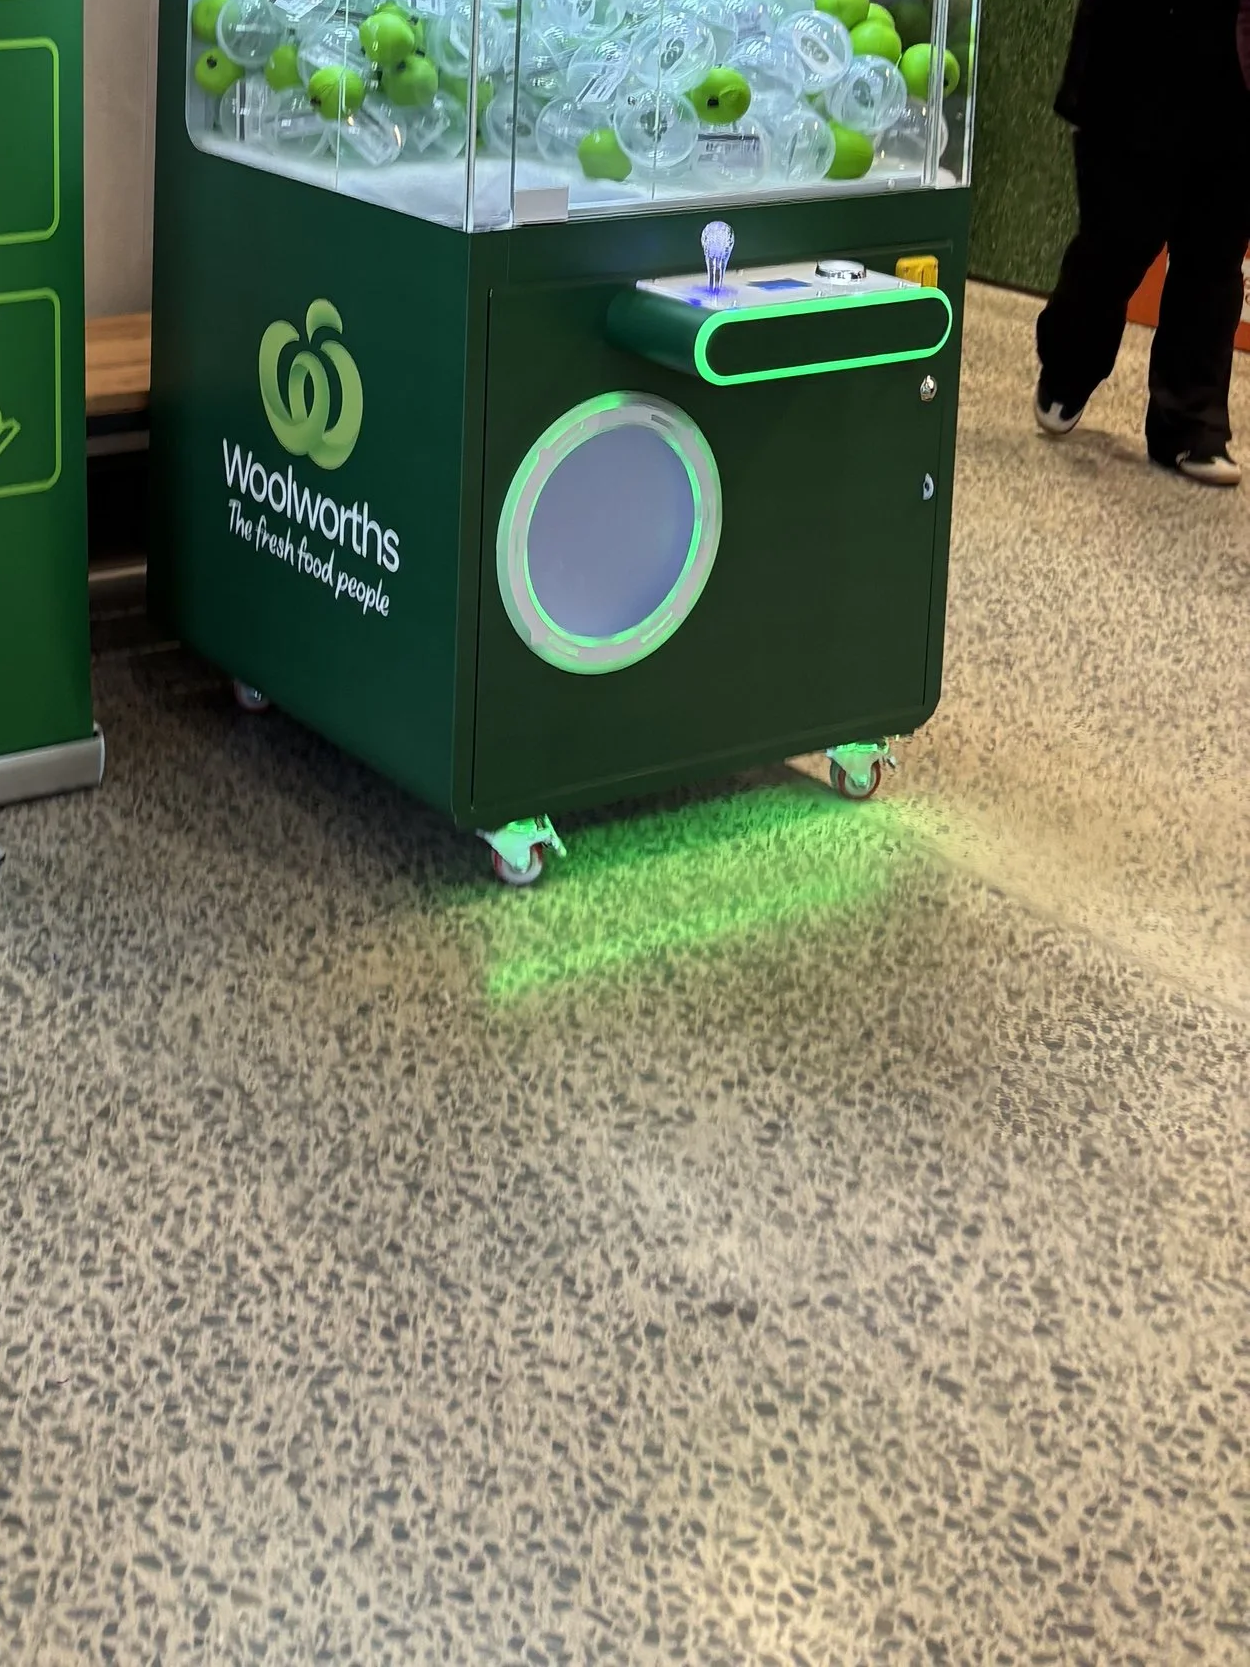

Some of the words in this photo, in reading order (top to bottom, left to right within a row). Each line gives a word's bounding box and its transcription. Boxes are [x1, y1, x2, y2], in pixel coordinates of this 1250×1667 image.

[223, 437, 400, 573] Woolworths
[228, 498, 252, 542] The
[255, 514, 294, 566] fresh
[298, 535, 334, 587] food
[335, 570, 390, 617] people
